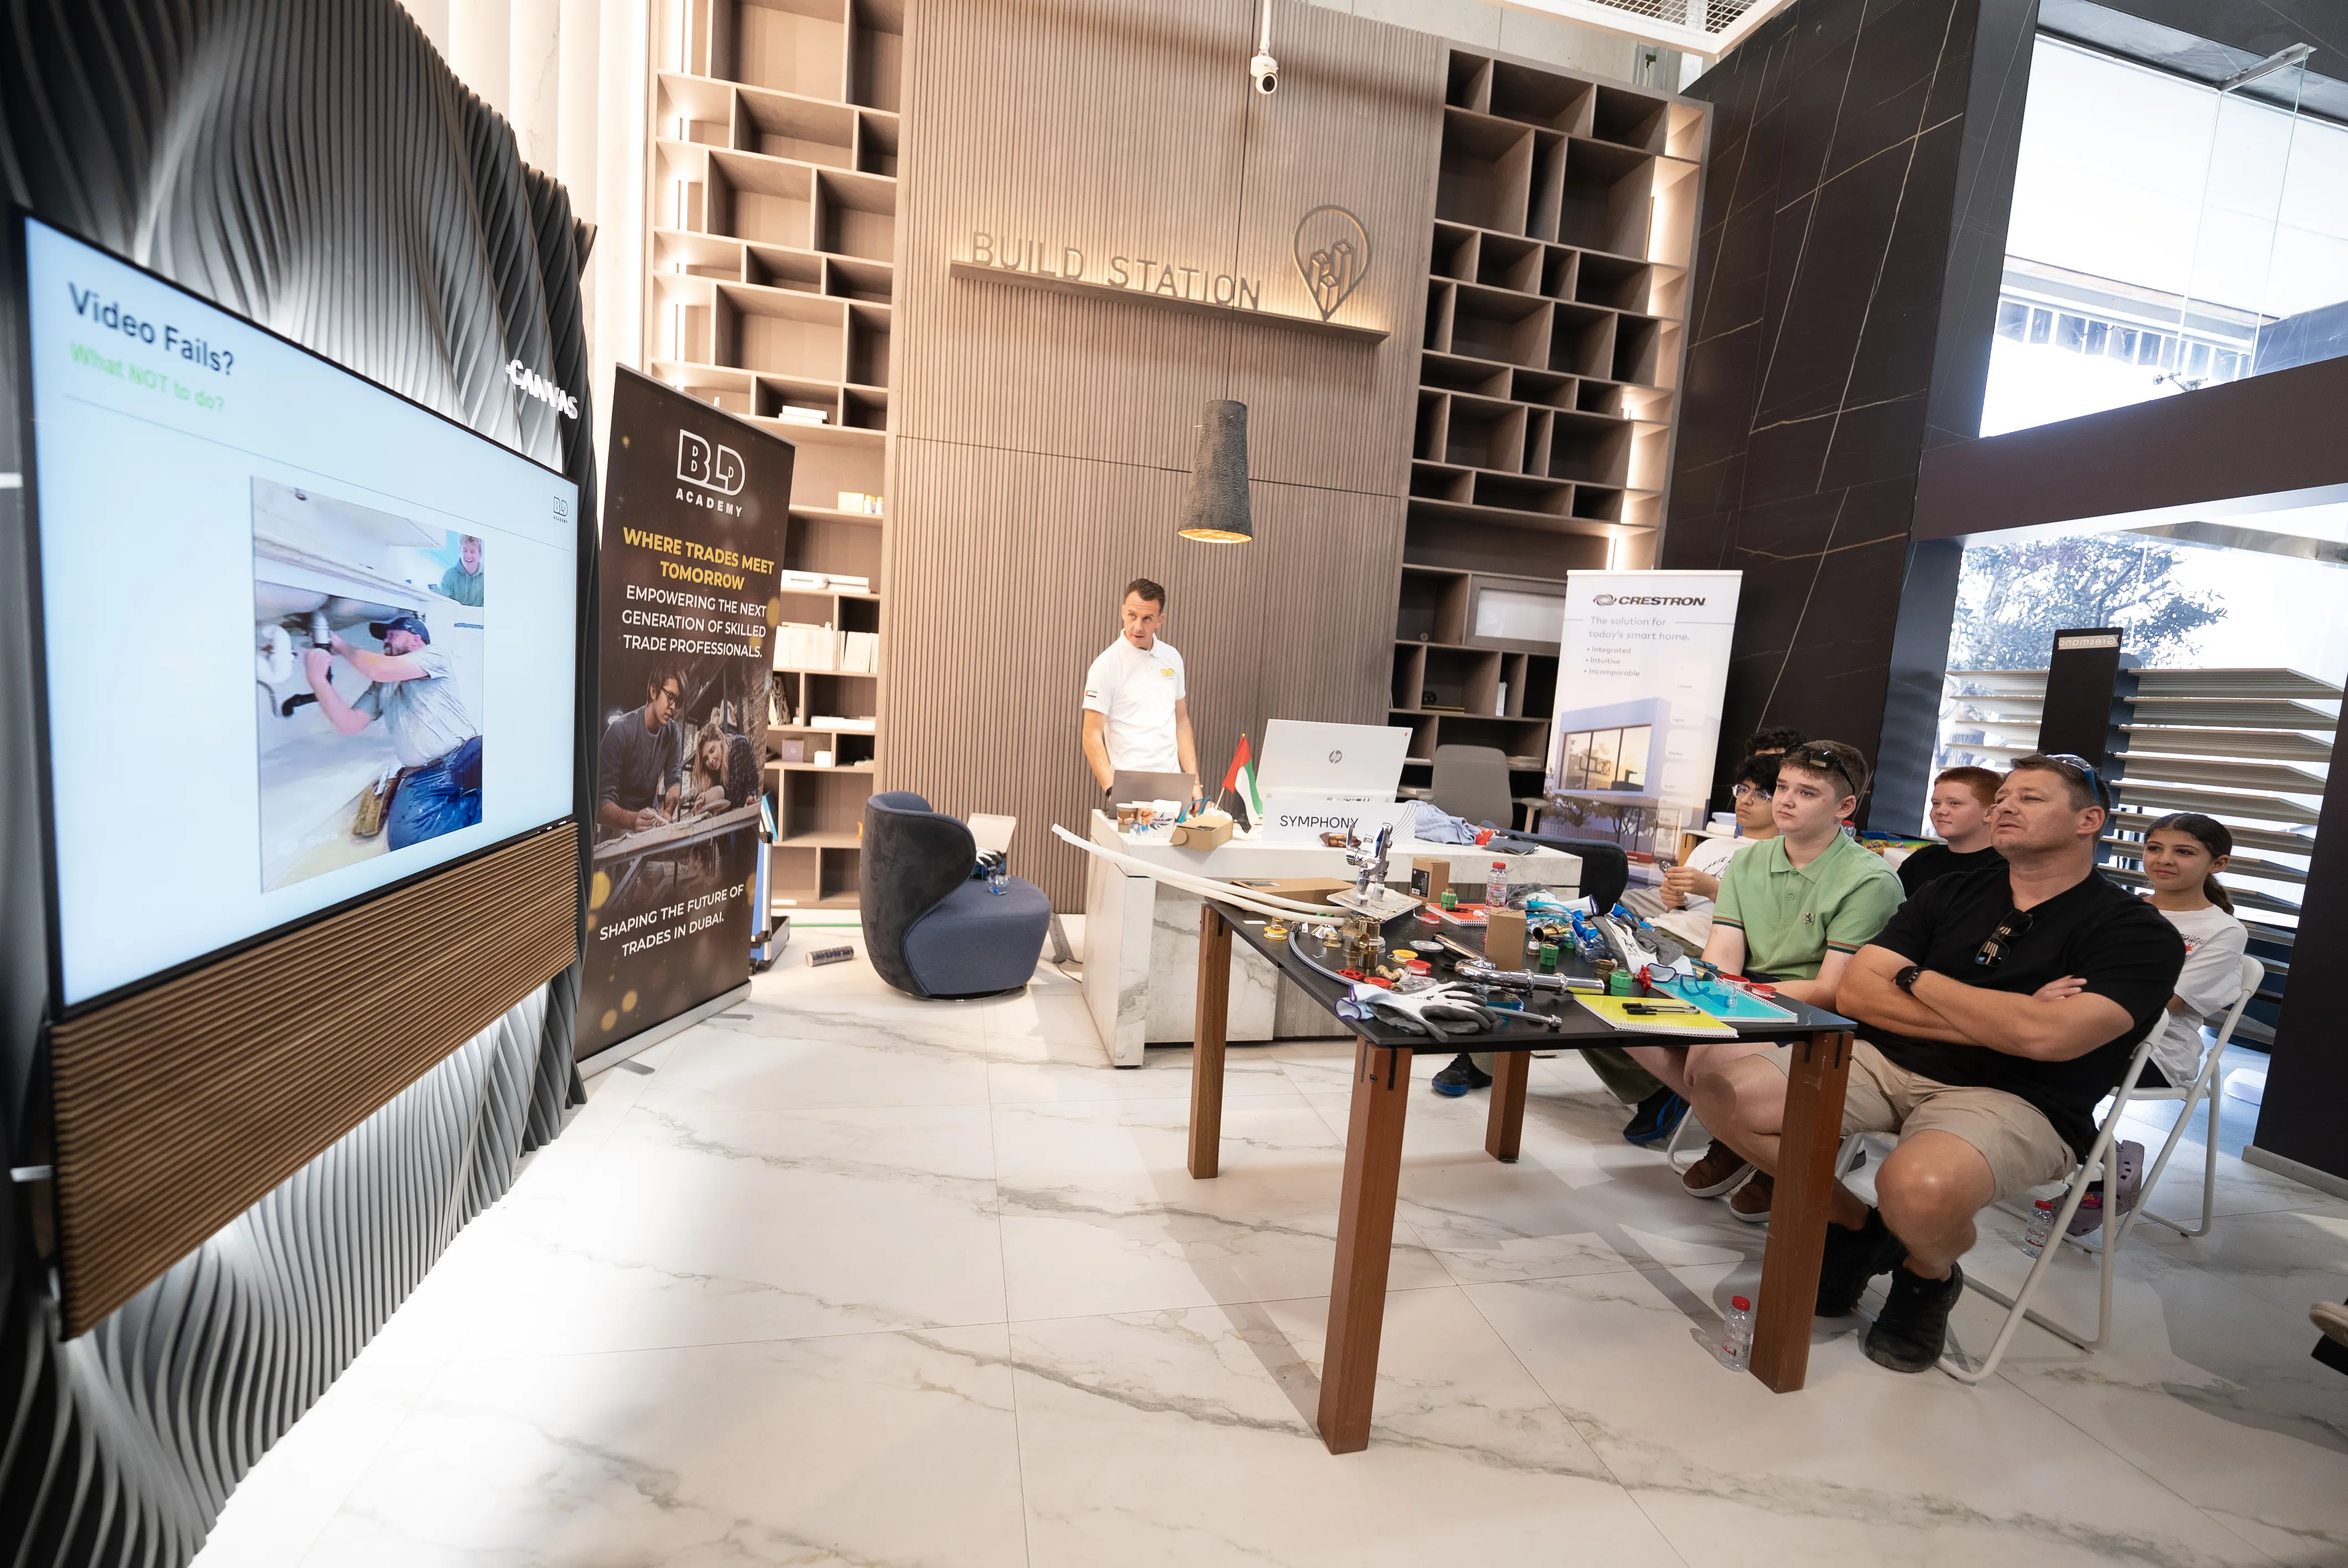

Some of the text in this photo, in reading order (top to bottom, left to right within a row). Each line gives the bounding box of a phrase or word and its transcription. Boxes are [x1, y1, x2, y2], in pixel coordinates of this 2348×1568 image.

[971, 230, 1260, 311] BUILD STATION
[67, 280, 235, 377] Video Fails?
[69, 340, 225, 413] What NOT to do?
[507, 359, 578, 419] CANVAS
[676, 488, 743, 518] ACADEMY
[623, 527, 775, 575] WHERE TRADES MEET
[660, 560, 745, 591] TOMORROW
[626, 585, 767, 618] EMPOWERING THE NEXT
[1619, 596, 1706, 606] CRESTRON
[621, 609, 766, 638] GENERATION OF SKILLED
[1589, 630, 1690, 641] today's smart home.
[1590, 616, 1667, 627] The solution for
[623, 634, 763, 658] TRADE PROFESSIONALS.
[1589, 668, 1640, 677] Incomparable
[1329, 750, 1342, 764] hp
[1280, 815, 1359, 828] SYMPHONY
[599, 884, 744, 941] SHAPING THE FUTURE OF
[621, 911, 724, 957] TRADES IN DUBAI.
